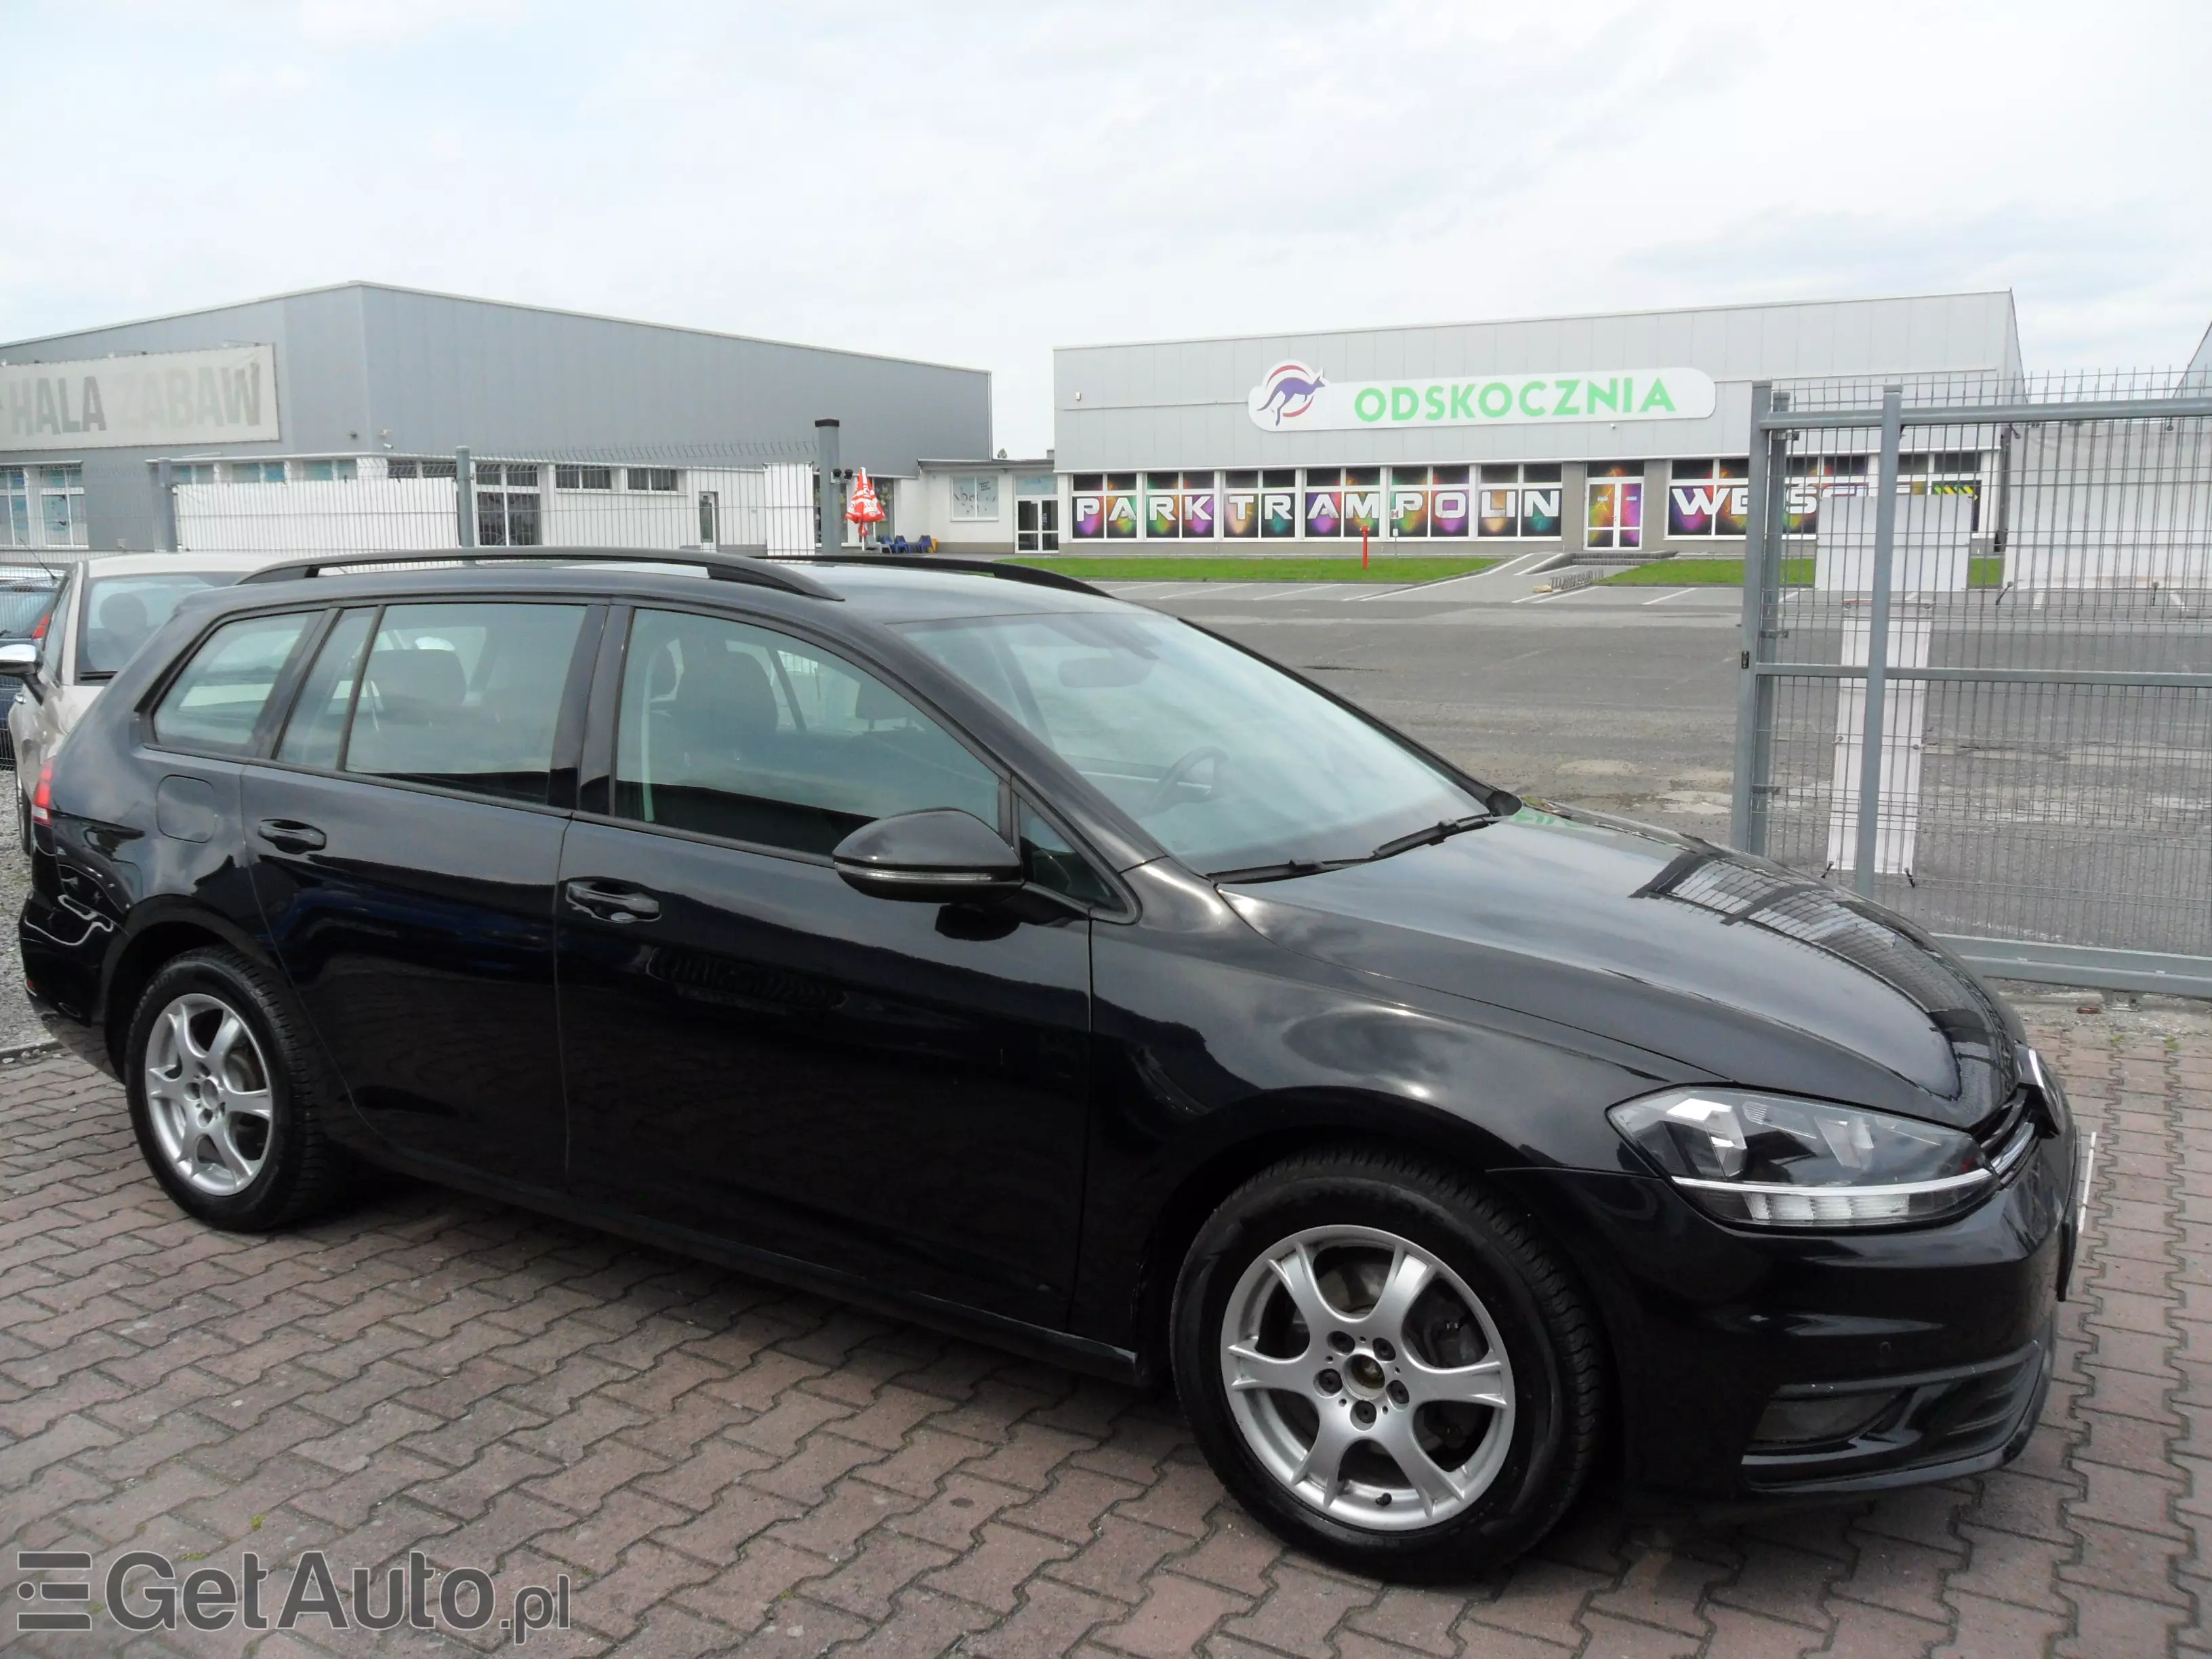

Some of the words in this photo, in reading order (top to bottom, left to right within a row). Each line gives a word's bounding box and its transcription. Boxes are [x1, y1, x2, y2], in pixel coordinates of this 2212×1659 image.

[10, 376, 106, 436] HALA
[117, 362, 261, 428] ZABAW
[1355, 377, 1675, 422] ODSKOCZNIA
[1076, 495, 1212, 521] PARK
[1229, 491, 1559, 520] TRAMPOLIN
